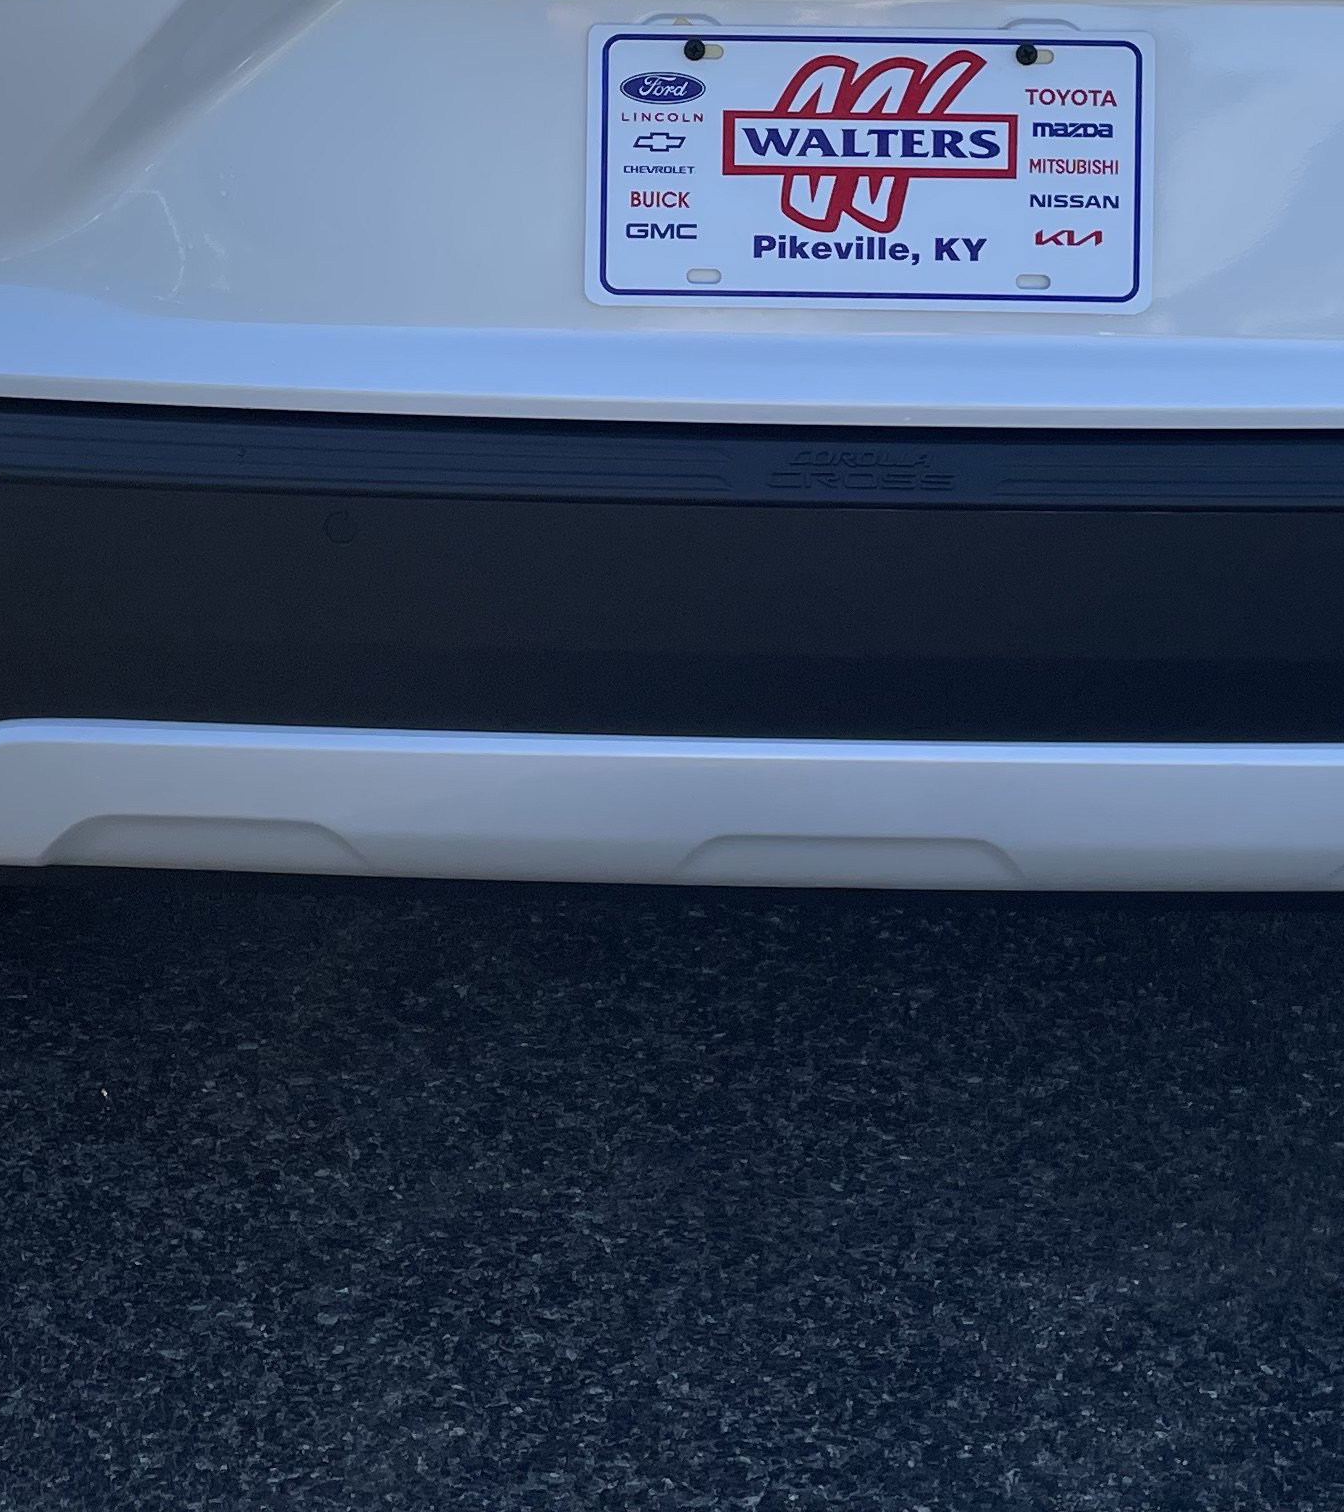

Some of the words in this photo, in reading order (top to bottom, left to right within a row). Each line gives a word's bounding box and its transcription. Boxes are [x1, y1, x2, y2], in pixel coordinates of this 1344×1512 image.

[638, 76, 689, 96] Ford
[1025, 88, 1118, 107] TOYOTA
[621, 112, 704, 123] LINCOLN
[741, 128, 1001, 159] WALTERS
[623, 165, 695, 175] CHEVROLET
[1029, 158, 1119, 175] MITSUBISHI
[629, 190, 690, 209] BUICK
[1029, 194, 1120, 209] NISSAN
[625, 223, 698, 240] GMC
[1035, 230, 1103, 246] KIA
[754, 235, 920, 265] Pikeville,
[934, 237, 987, 262] KY
[788, 450, 932, 468] COROLLA
[765, 472, 955, 489] CROSS
